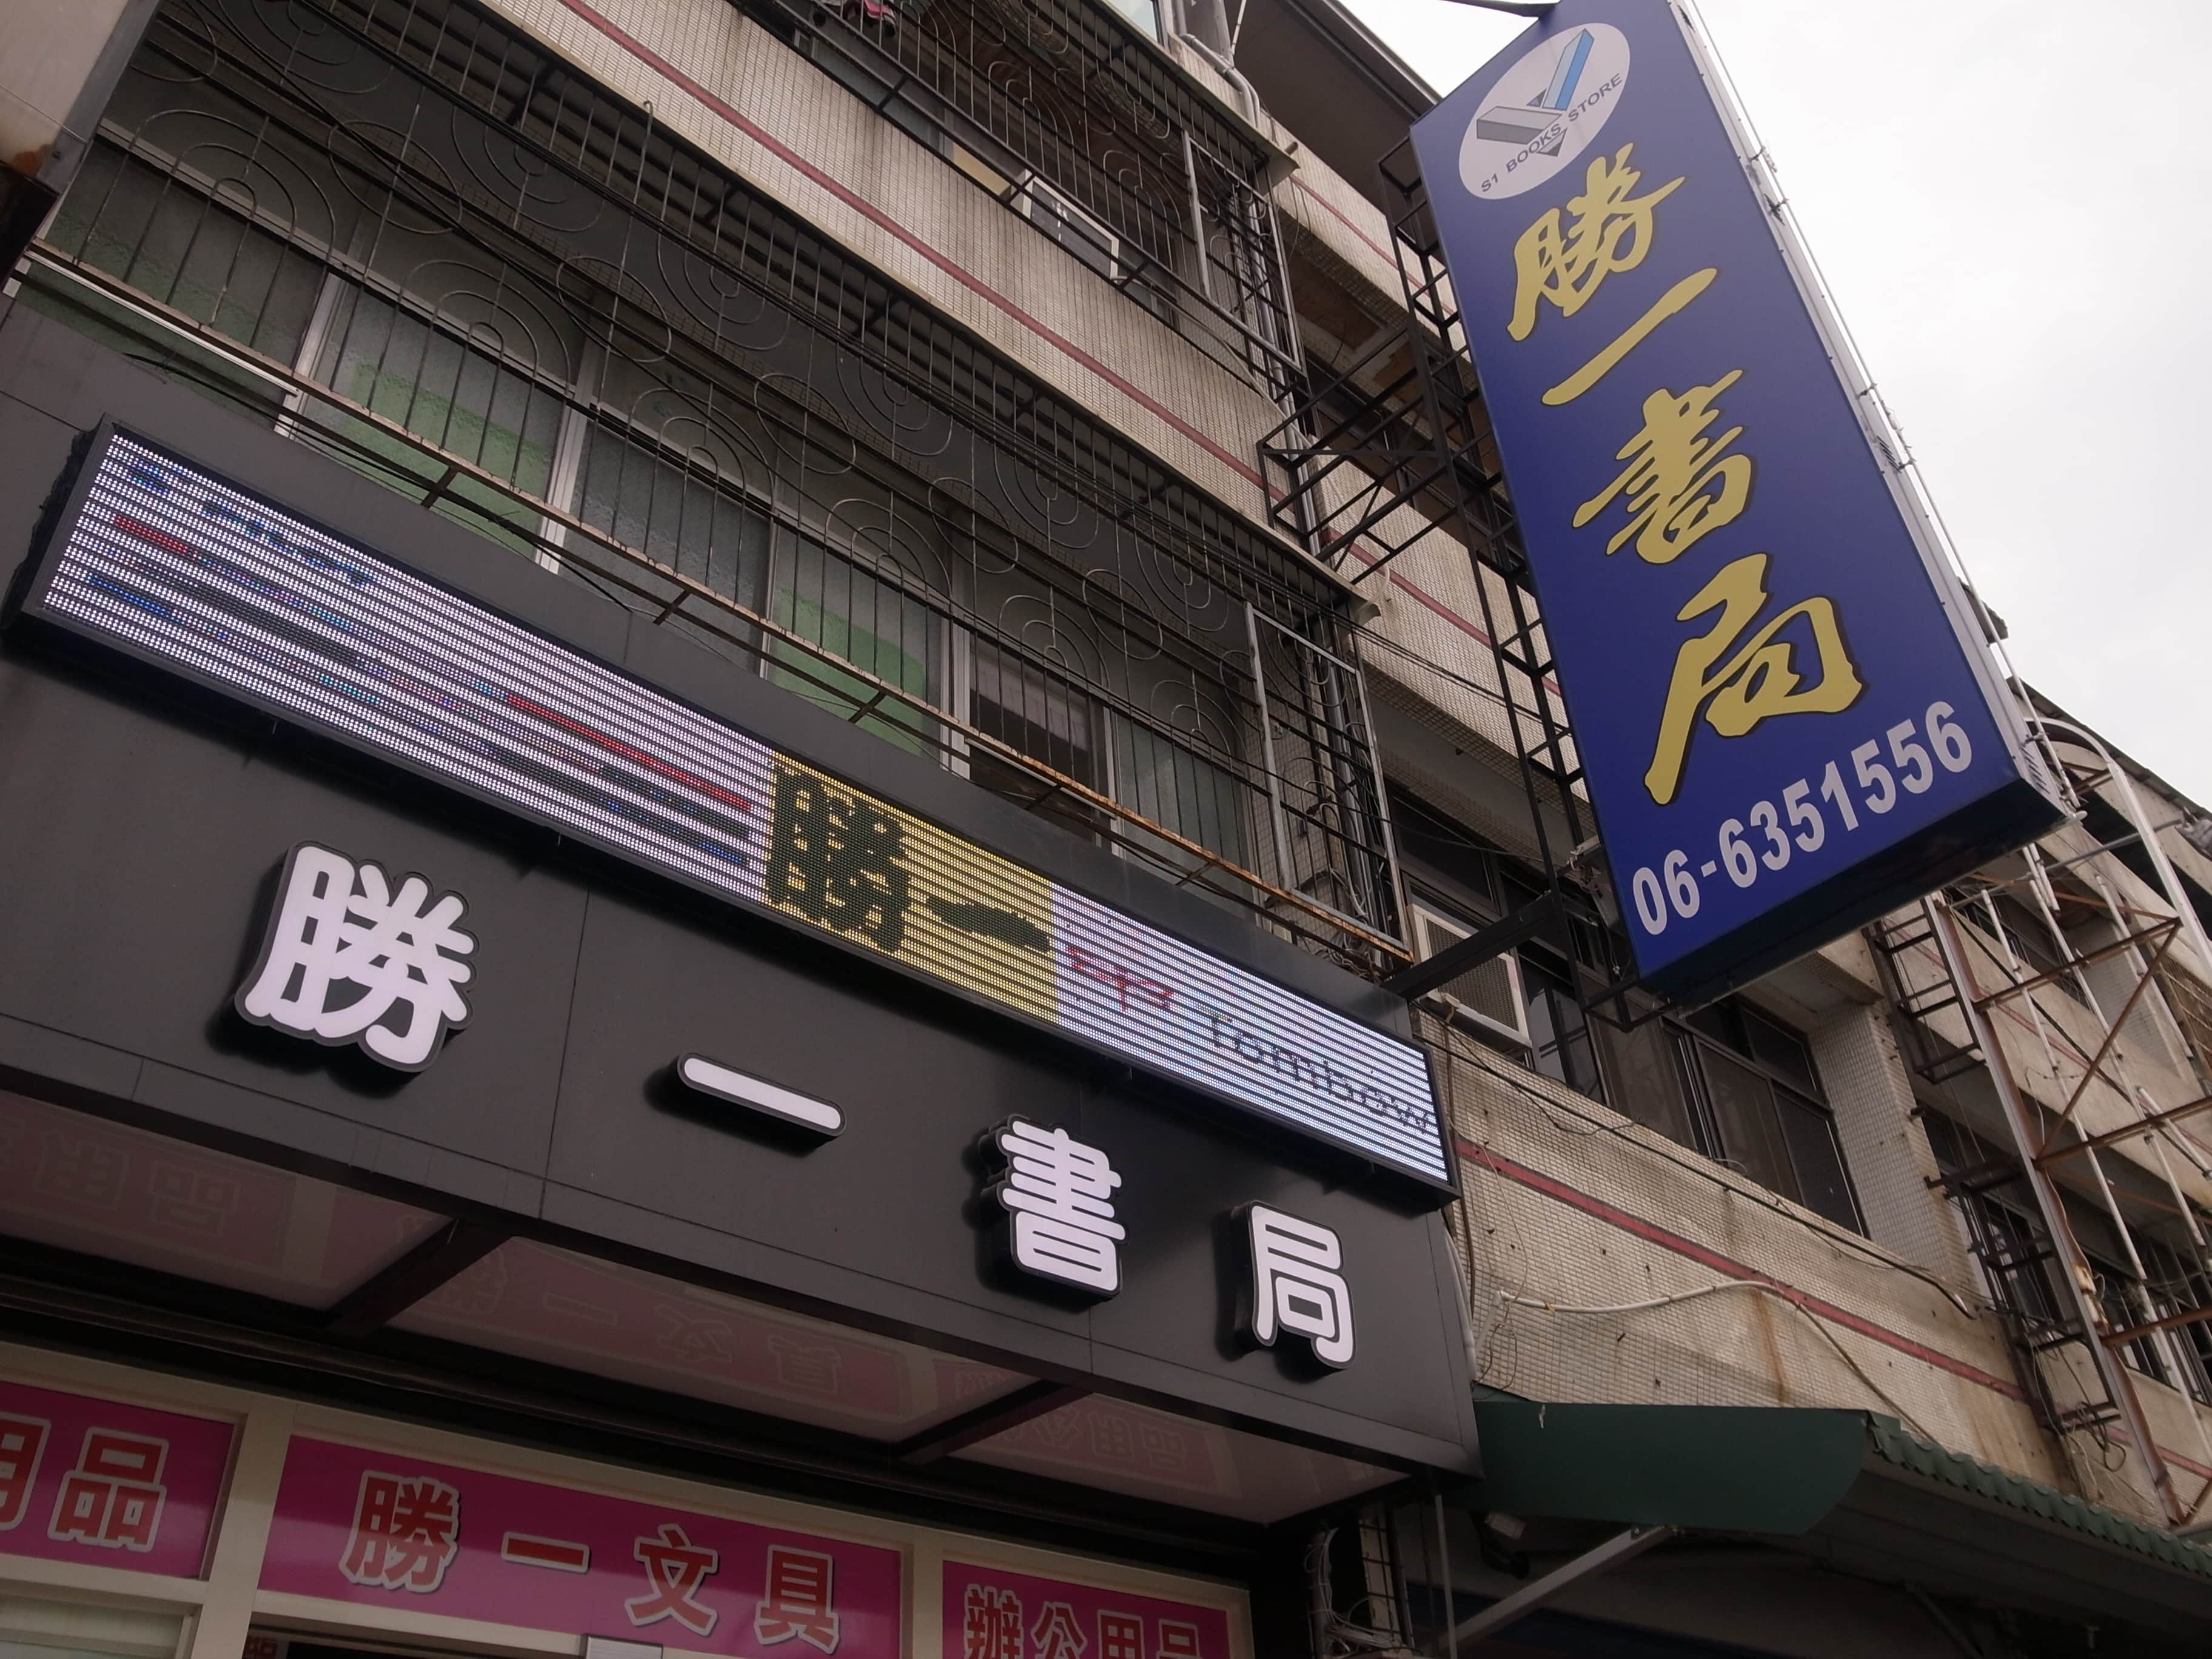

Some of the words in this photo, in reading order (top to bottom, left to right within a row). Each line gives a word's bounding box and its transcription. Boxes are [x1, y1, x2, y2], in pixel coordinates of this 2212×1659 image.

[1481, 173, 1500, 193] S1
[1505, 124, 1562, 173] BOOKS
[1567, 73, 1623, 122] STORE
[1507, 143, 1862, 805] 勝一書局
[1633, 702, 1972, 935] 06-6351556
[238, 844, 1358, 1369] 勝一書局
[339, 1470, 840, 1654] 勝一文具
